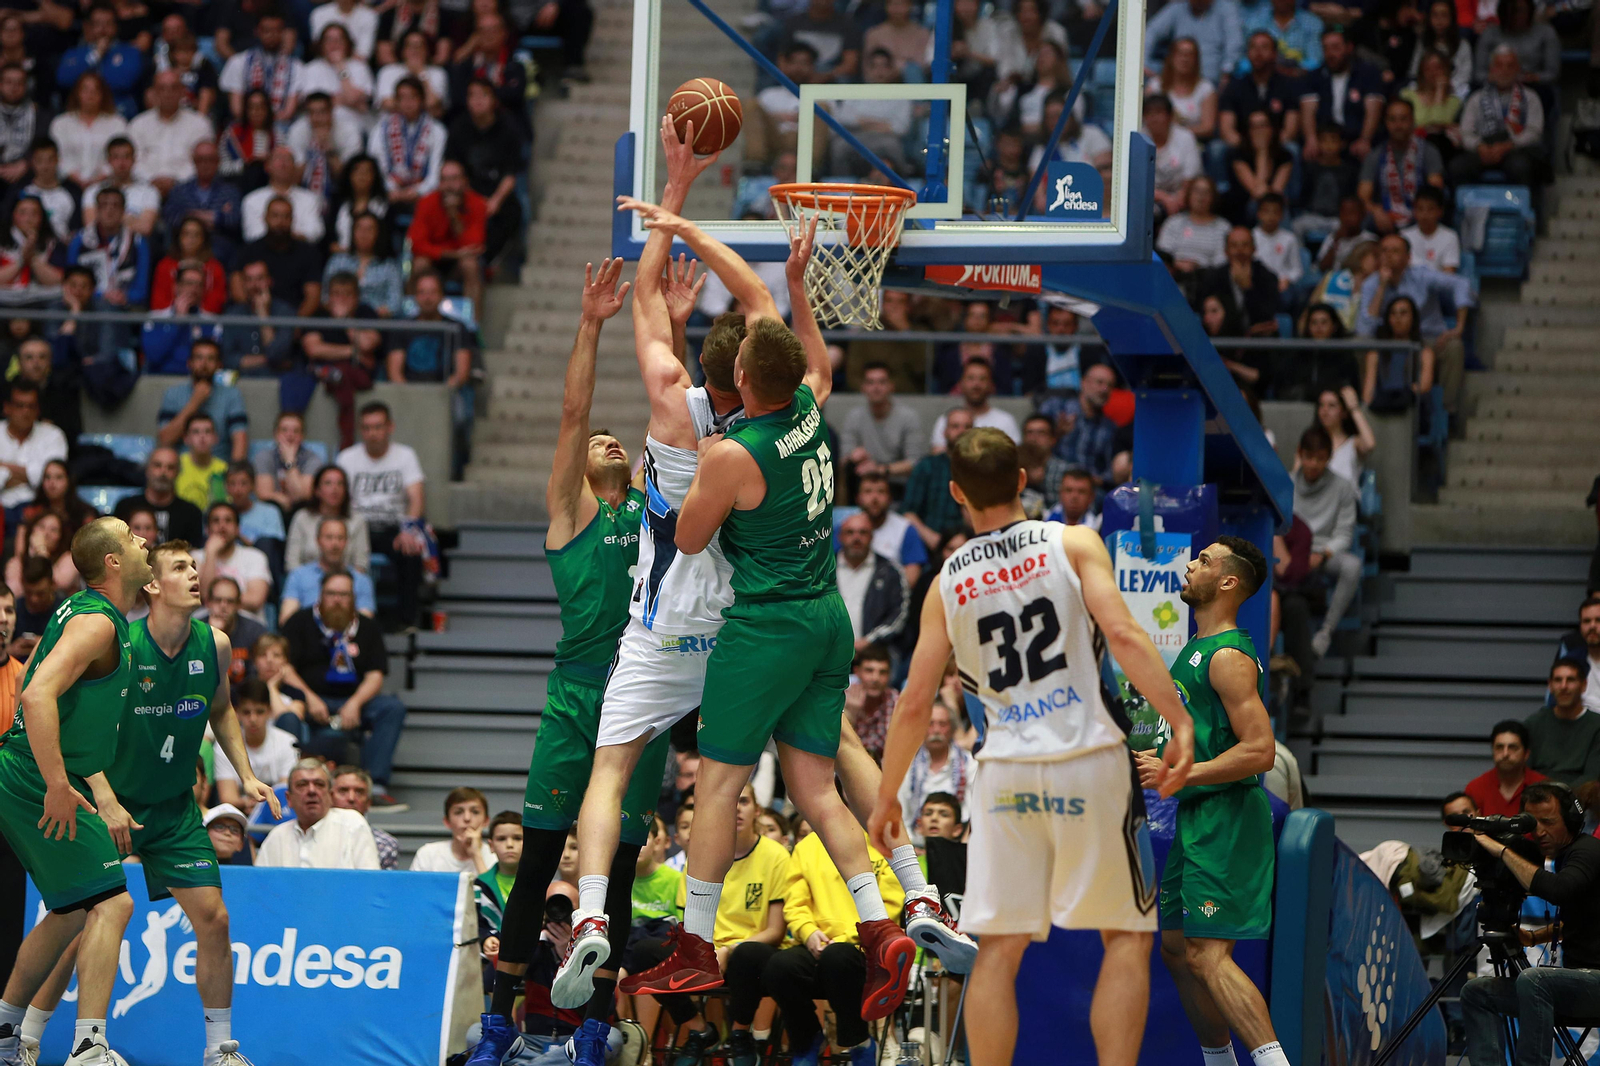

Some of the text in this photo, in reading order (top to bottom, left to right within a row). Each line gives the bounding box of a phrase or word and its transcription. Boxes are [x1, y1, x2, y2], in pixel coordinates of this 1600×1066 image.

[1064, 199, 1098, 211] endesa
[1125, 542, 1185, 554] Enera
[1120, 569, 1183, 593] LEYMA
[978, 597, 1067, 693] 32
[177, 700, 200, 714] plus
[160, 734, 175, 763] 4
